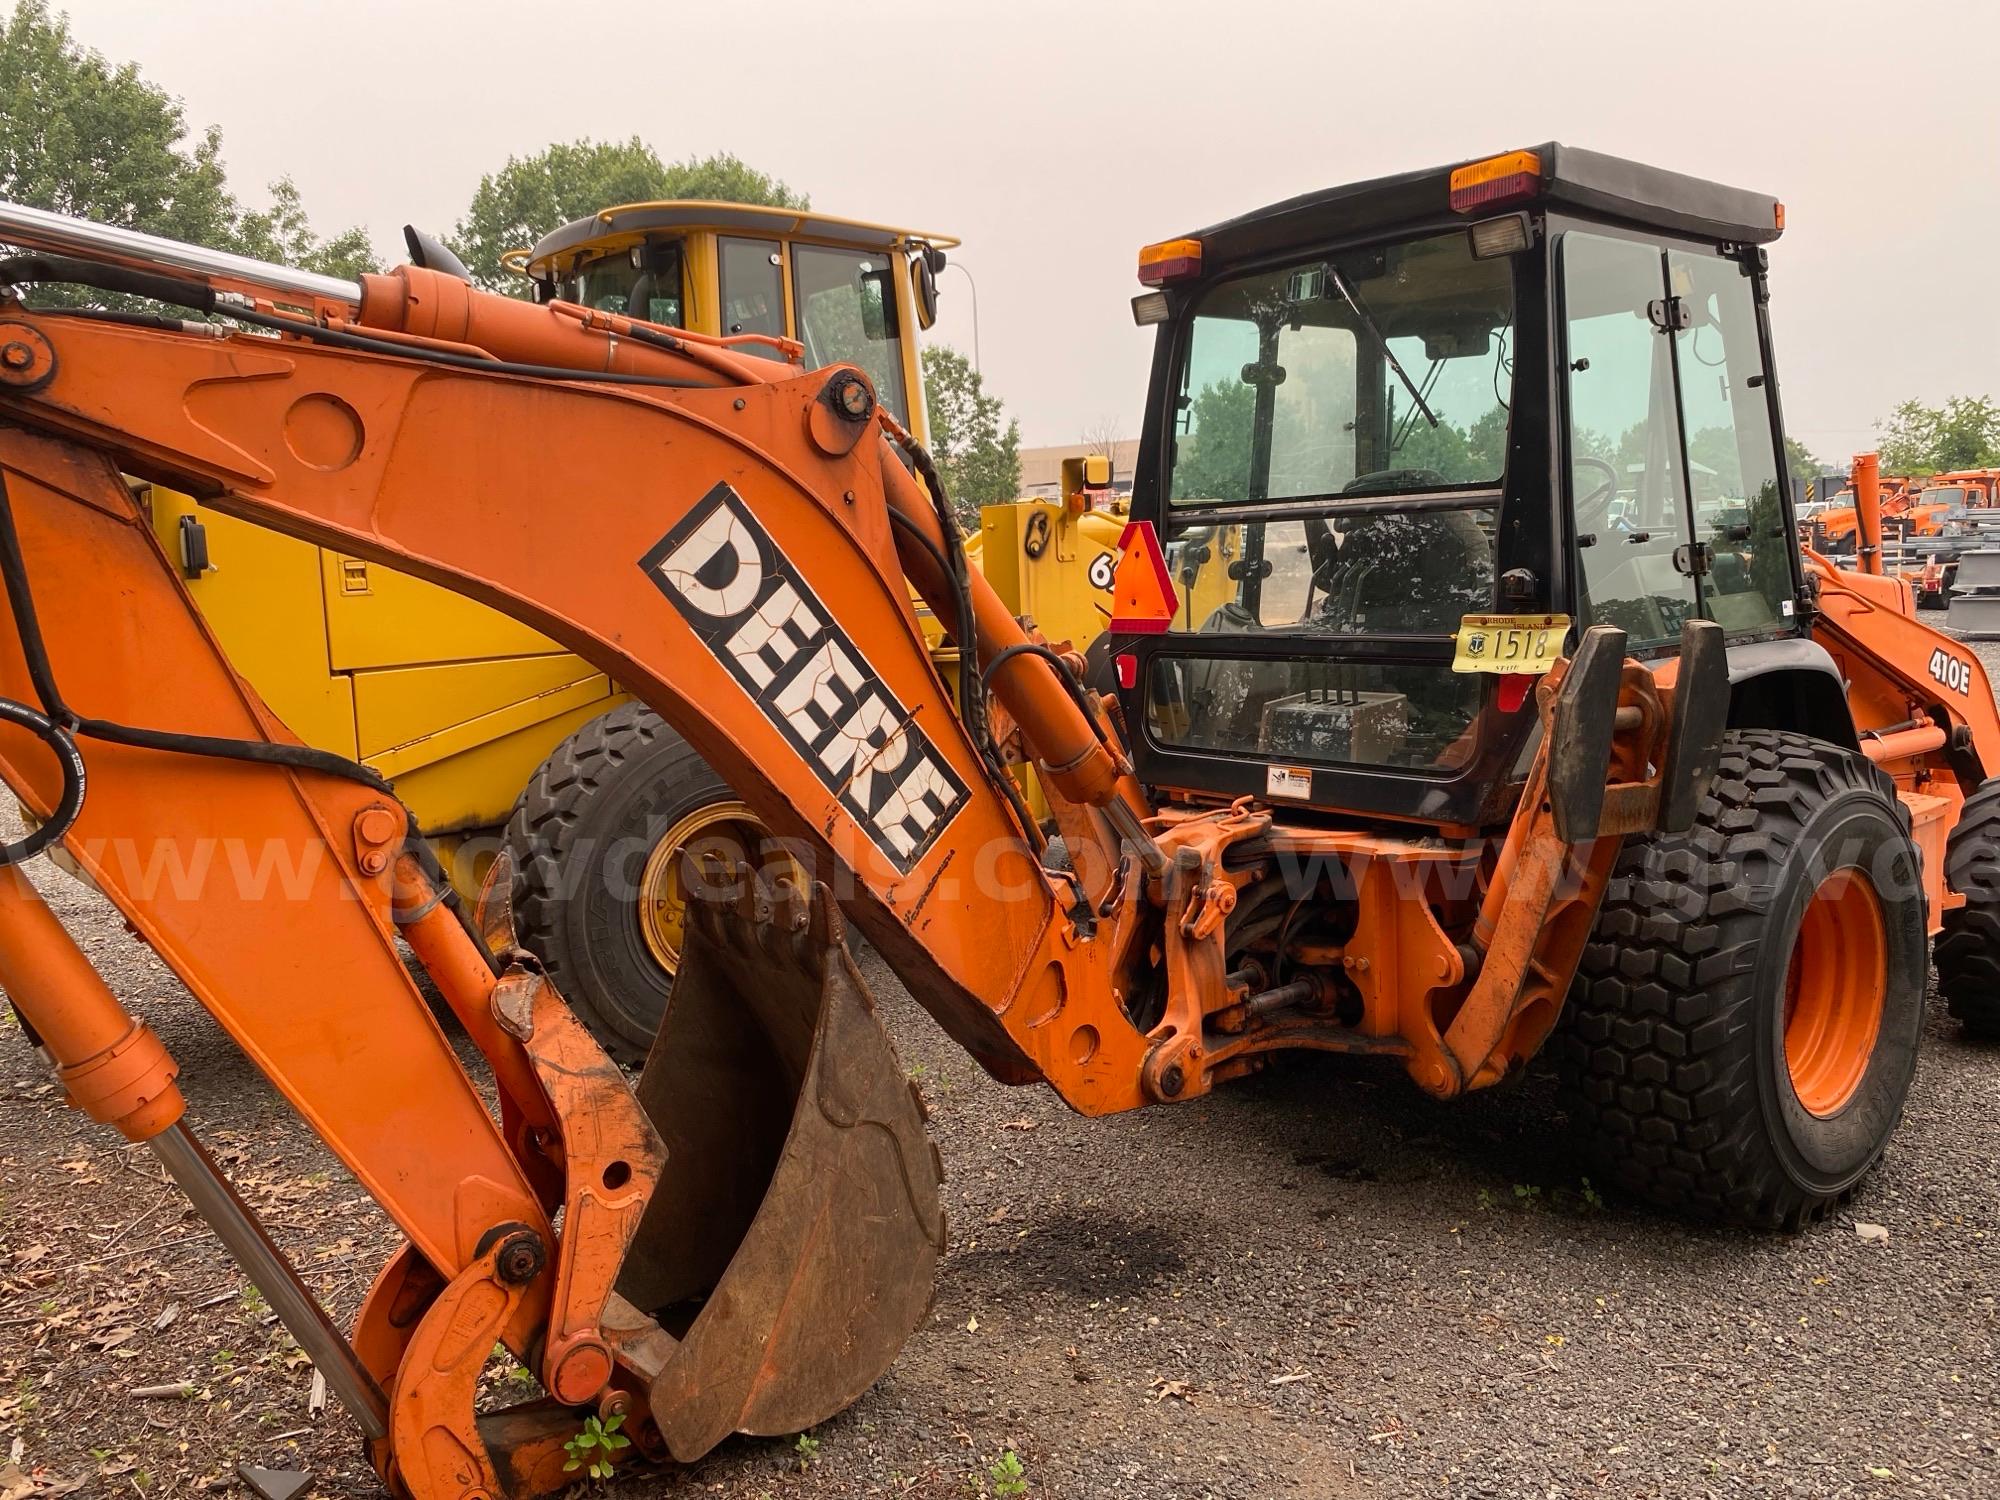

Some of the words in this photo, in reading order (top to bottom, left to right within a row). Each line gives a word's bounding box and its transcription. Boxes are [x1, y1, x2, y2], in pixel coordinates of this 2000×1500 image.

[1487, 617, 1517, 625] RHODE
[1494, 630, 1549, 660] 1518
[660, 502, 959, 859] DEERE
[1928, 647, 1971, 698] 410E
